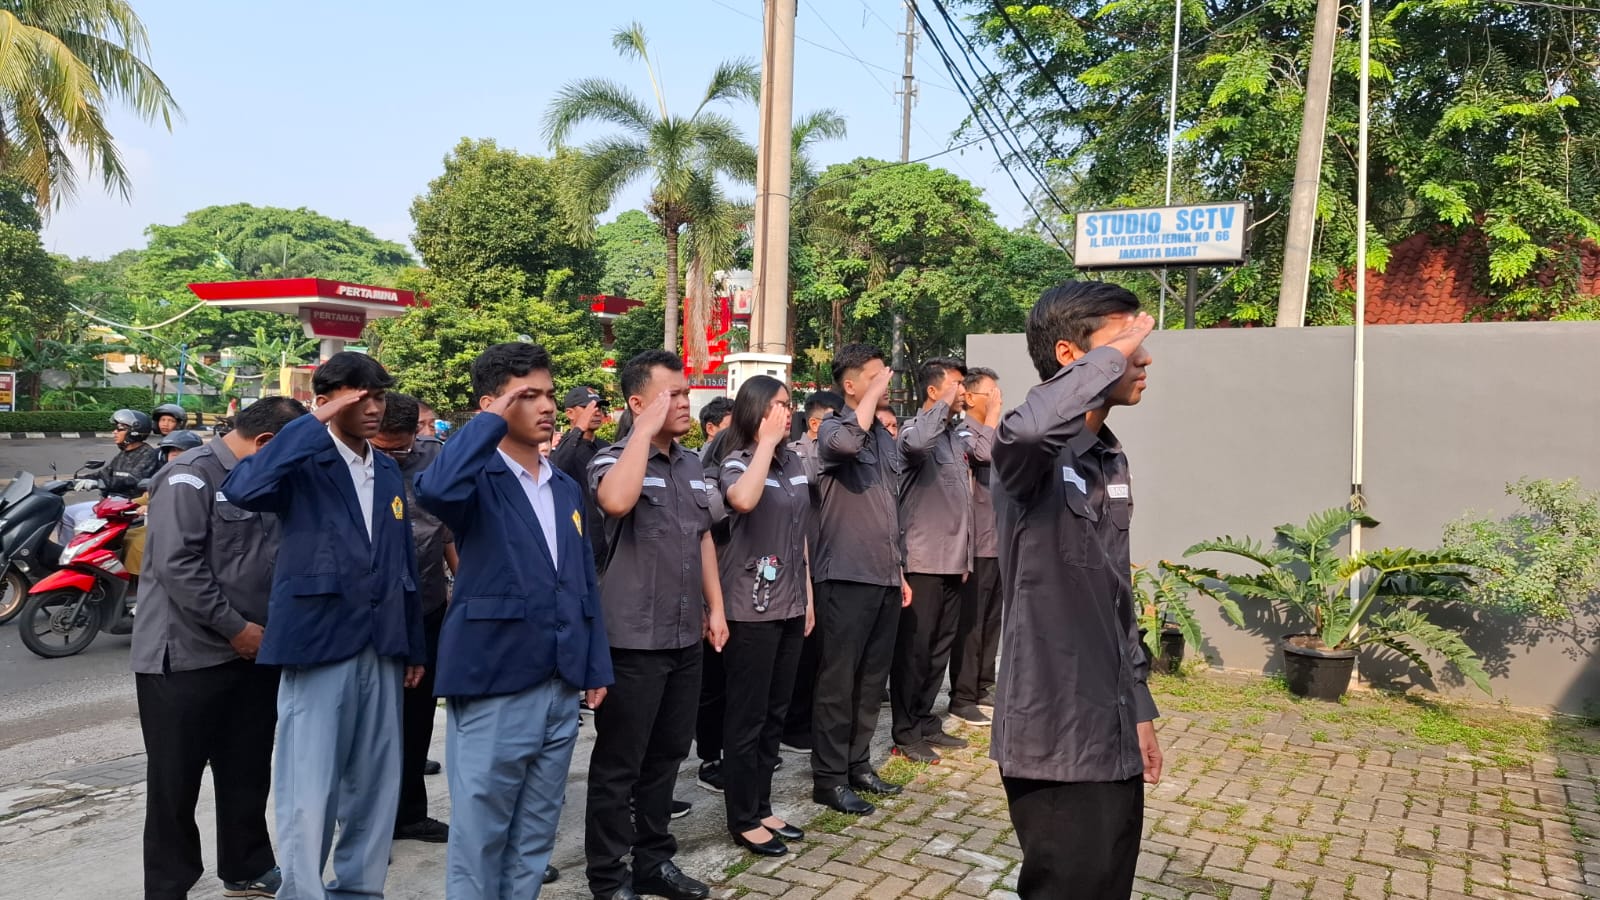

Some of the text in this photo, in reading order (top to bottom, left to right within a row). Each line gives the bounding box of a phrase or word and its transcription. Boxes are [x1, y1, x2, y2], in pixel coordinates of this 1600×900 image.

[1085, 207, 1235, 237] STUDIO SCTV
[1102, 236, 1127, 247] RAYA
[1127, 234, 1160, 246] KEBON
[1161, 233, 1192, 244] JERUK
[1194, 231, 1209, 243] NO
[1215, 230, 1230, 242] 66
[1119, 246, 1198, 260] JAKARTA BARAT
[336, 285, 399, 302] PERTAMINA
[313, 310, 361, 323] PERTAMAX
